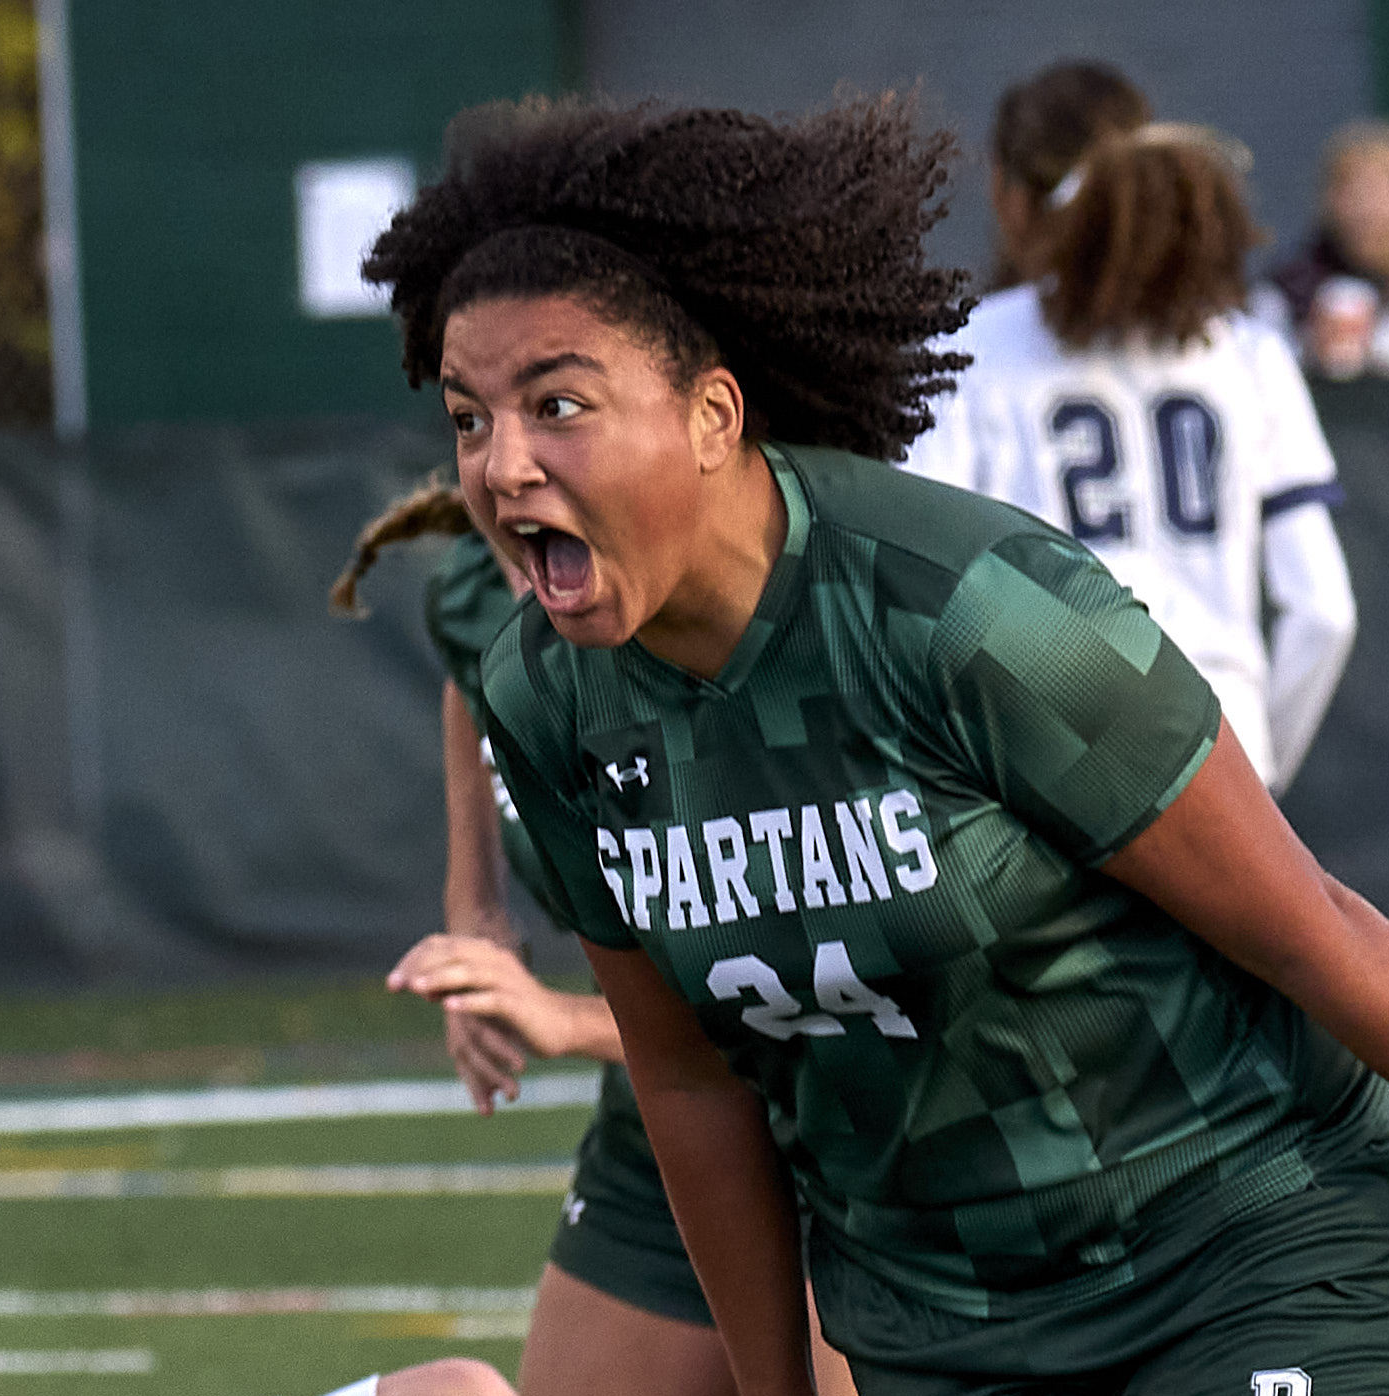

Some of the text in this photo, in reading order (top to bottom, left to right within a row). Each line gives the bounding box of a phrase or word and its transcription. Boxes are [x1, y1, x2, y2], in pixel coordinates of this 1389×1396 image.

[1049, 392, 1223, 541] 20
[596, 788, 939, 931] SPARTANS
[705, 939, 919, 1042] 24
